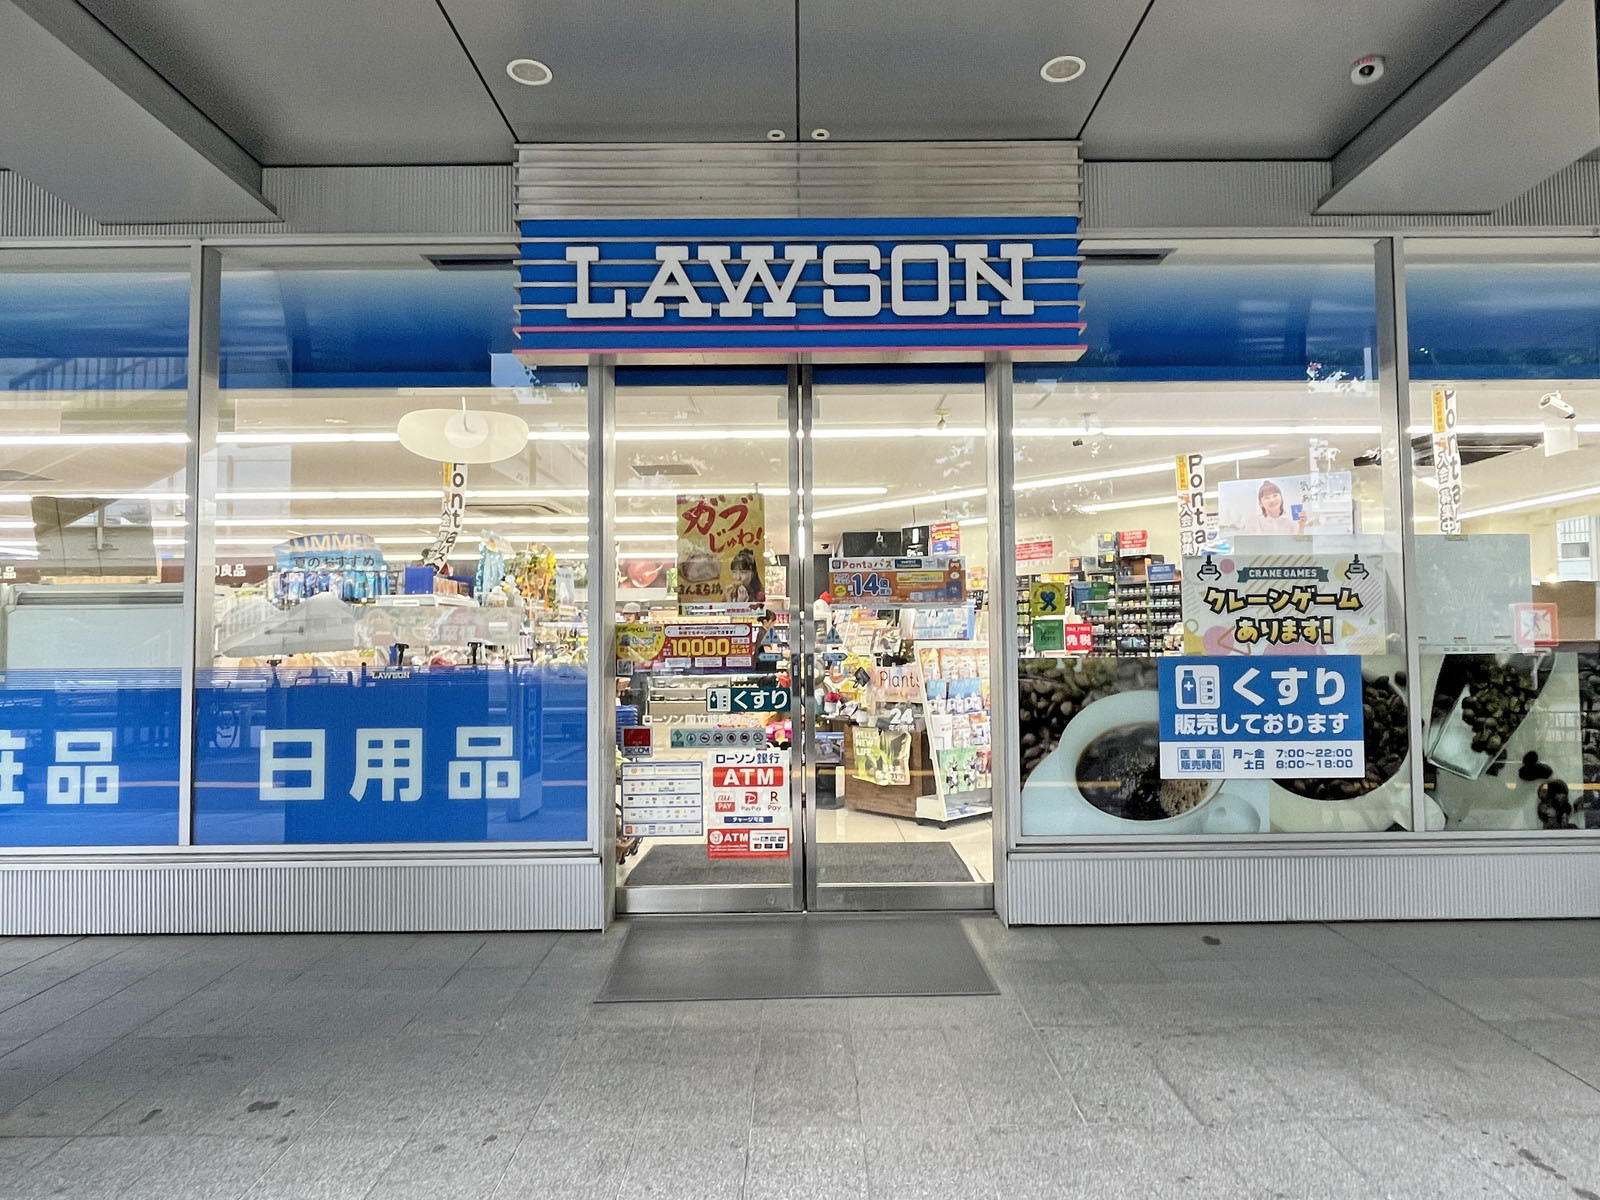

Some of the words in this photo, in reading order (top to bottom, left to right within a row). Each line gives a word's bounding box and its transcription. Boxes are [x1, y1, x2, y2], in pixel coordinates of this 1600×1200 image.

[566, 244, 1034, 318] LAWSON
[0, 566, 16, 579] 品
[1249, 569, 1282, 578] CRANE
[1284, 569, 1317, 578] GAMES
[851, 573, 880, 597] 14
[1204, 585, 1363, 614] クレーンゲーム
[1235, 616, 1334, 645] あります!
[1066, 634, 1092, 646] 免税
[1233, 667, 1346, 706] くすり
[733, 690, 788, 709] くすり
[889, 708, 914, 724] 24
[1175, 712, 1349, 736] 販売しております
[259, 726, 520, 802] 日用品
[715, 753, 780, 765] ローソン銀行
[1181, 760, 1222, 769] 販売時間
[1244, 760, 1265, 770] 土日
[723, 768, 774, 786] ATM
[770, 791, 778, 802] R
[767, 804, 781, 812] Pay
[724, 832, 748, 842] ATM
